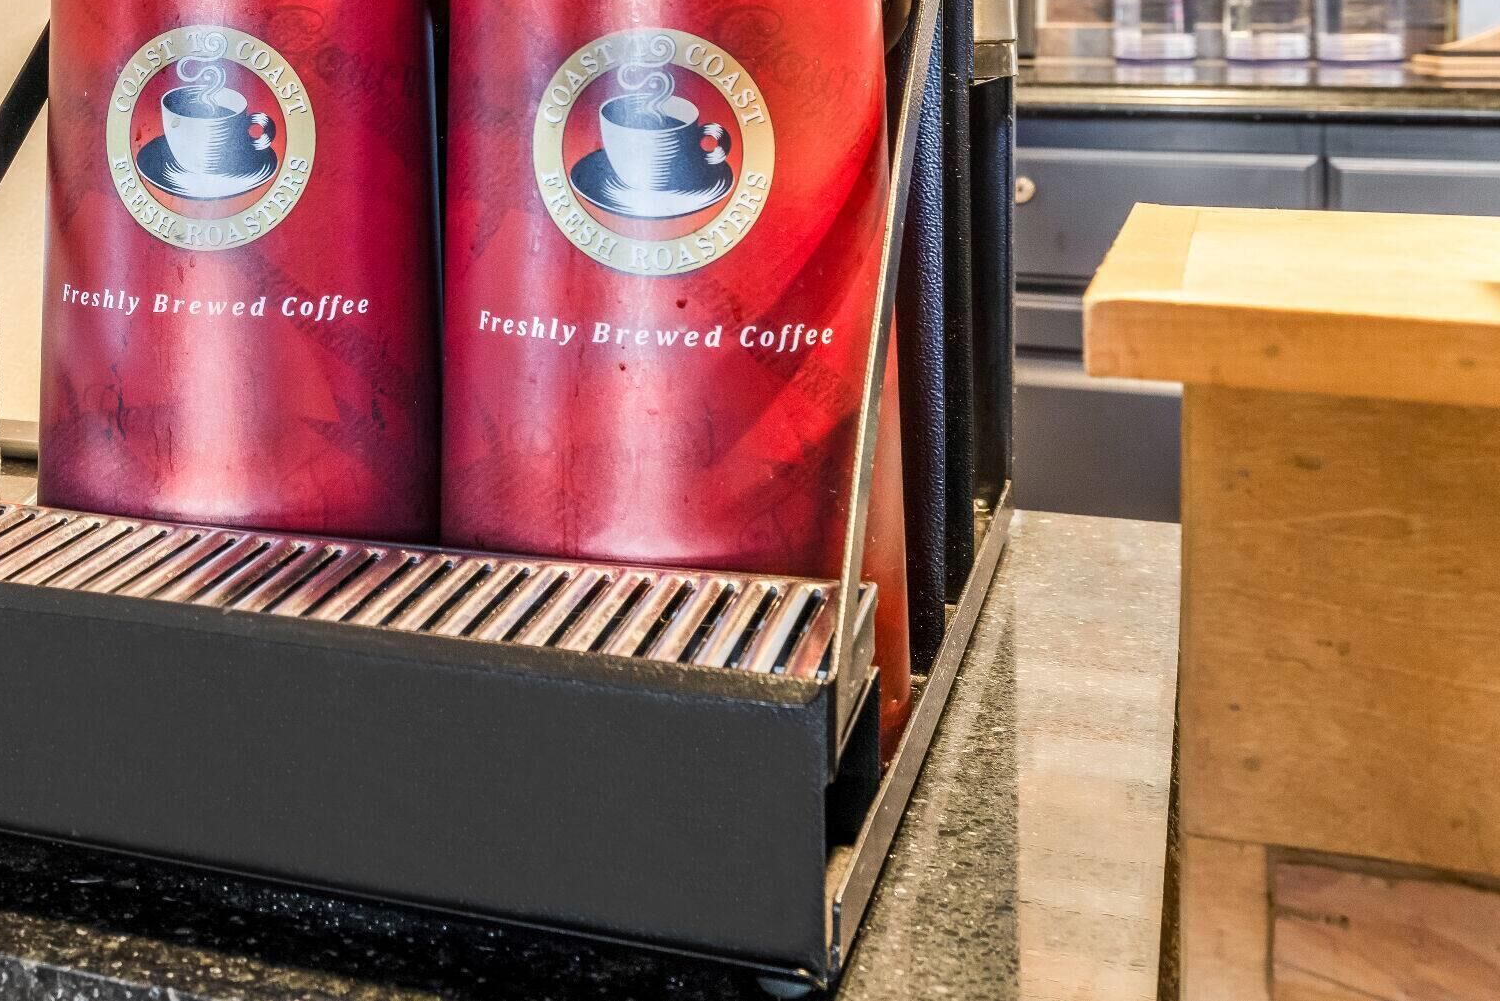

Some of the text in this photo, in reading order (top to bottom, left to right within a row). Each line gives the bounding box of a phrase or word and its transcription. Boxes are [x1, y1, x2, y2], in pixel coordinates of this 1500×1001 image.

[114, 40, 178, 113] COAST
[234, 39, 308, 115] COAST
[544, 42, 765, 126] COAST COAST
[113, 154, 309, 248] FRESH ROASTERS
[540, 170, 768, 272] FRESH ROASTERS
[62, 283, 369, 322] Freshly Brewed Coffee
[478, 310, 834, 353] Freshly Brewed Coffee
